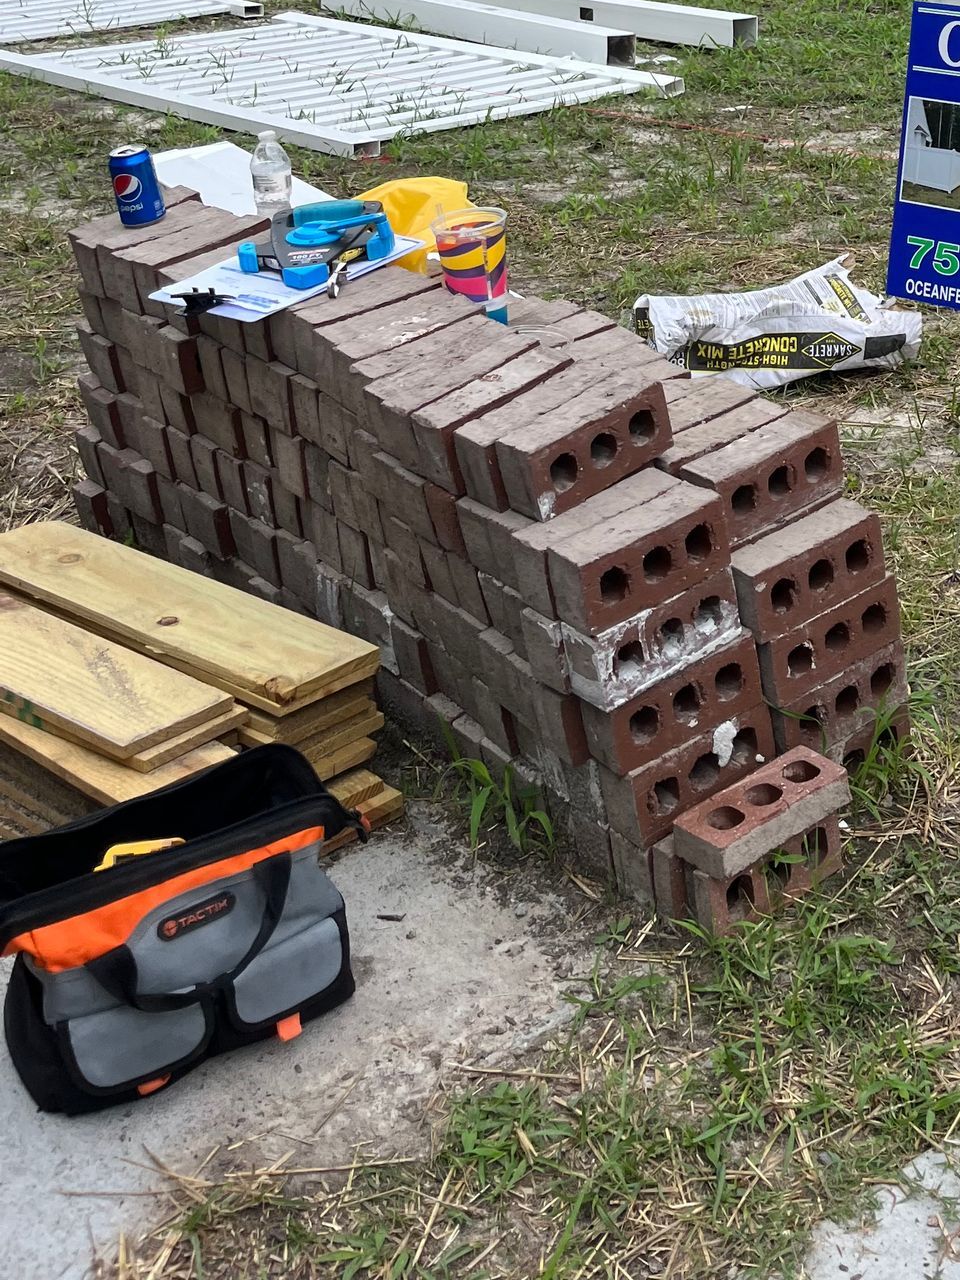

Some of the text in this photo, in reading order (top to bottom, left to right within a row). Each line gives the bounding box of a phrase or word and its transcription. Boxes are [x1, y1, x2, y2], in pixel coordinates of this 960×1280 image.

[120, 202, 144, 213] pepsi
[697, 336, 798, 360] CONCRETE MIX
[808, 344, 852, 357] SAKRETE
